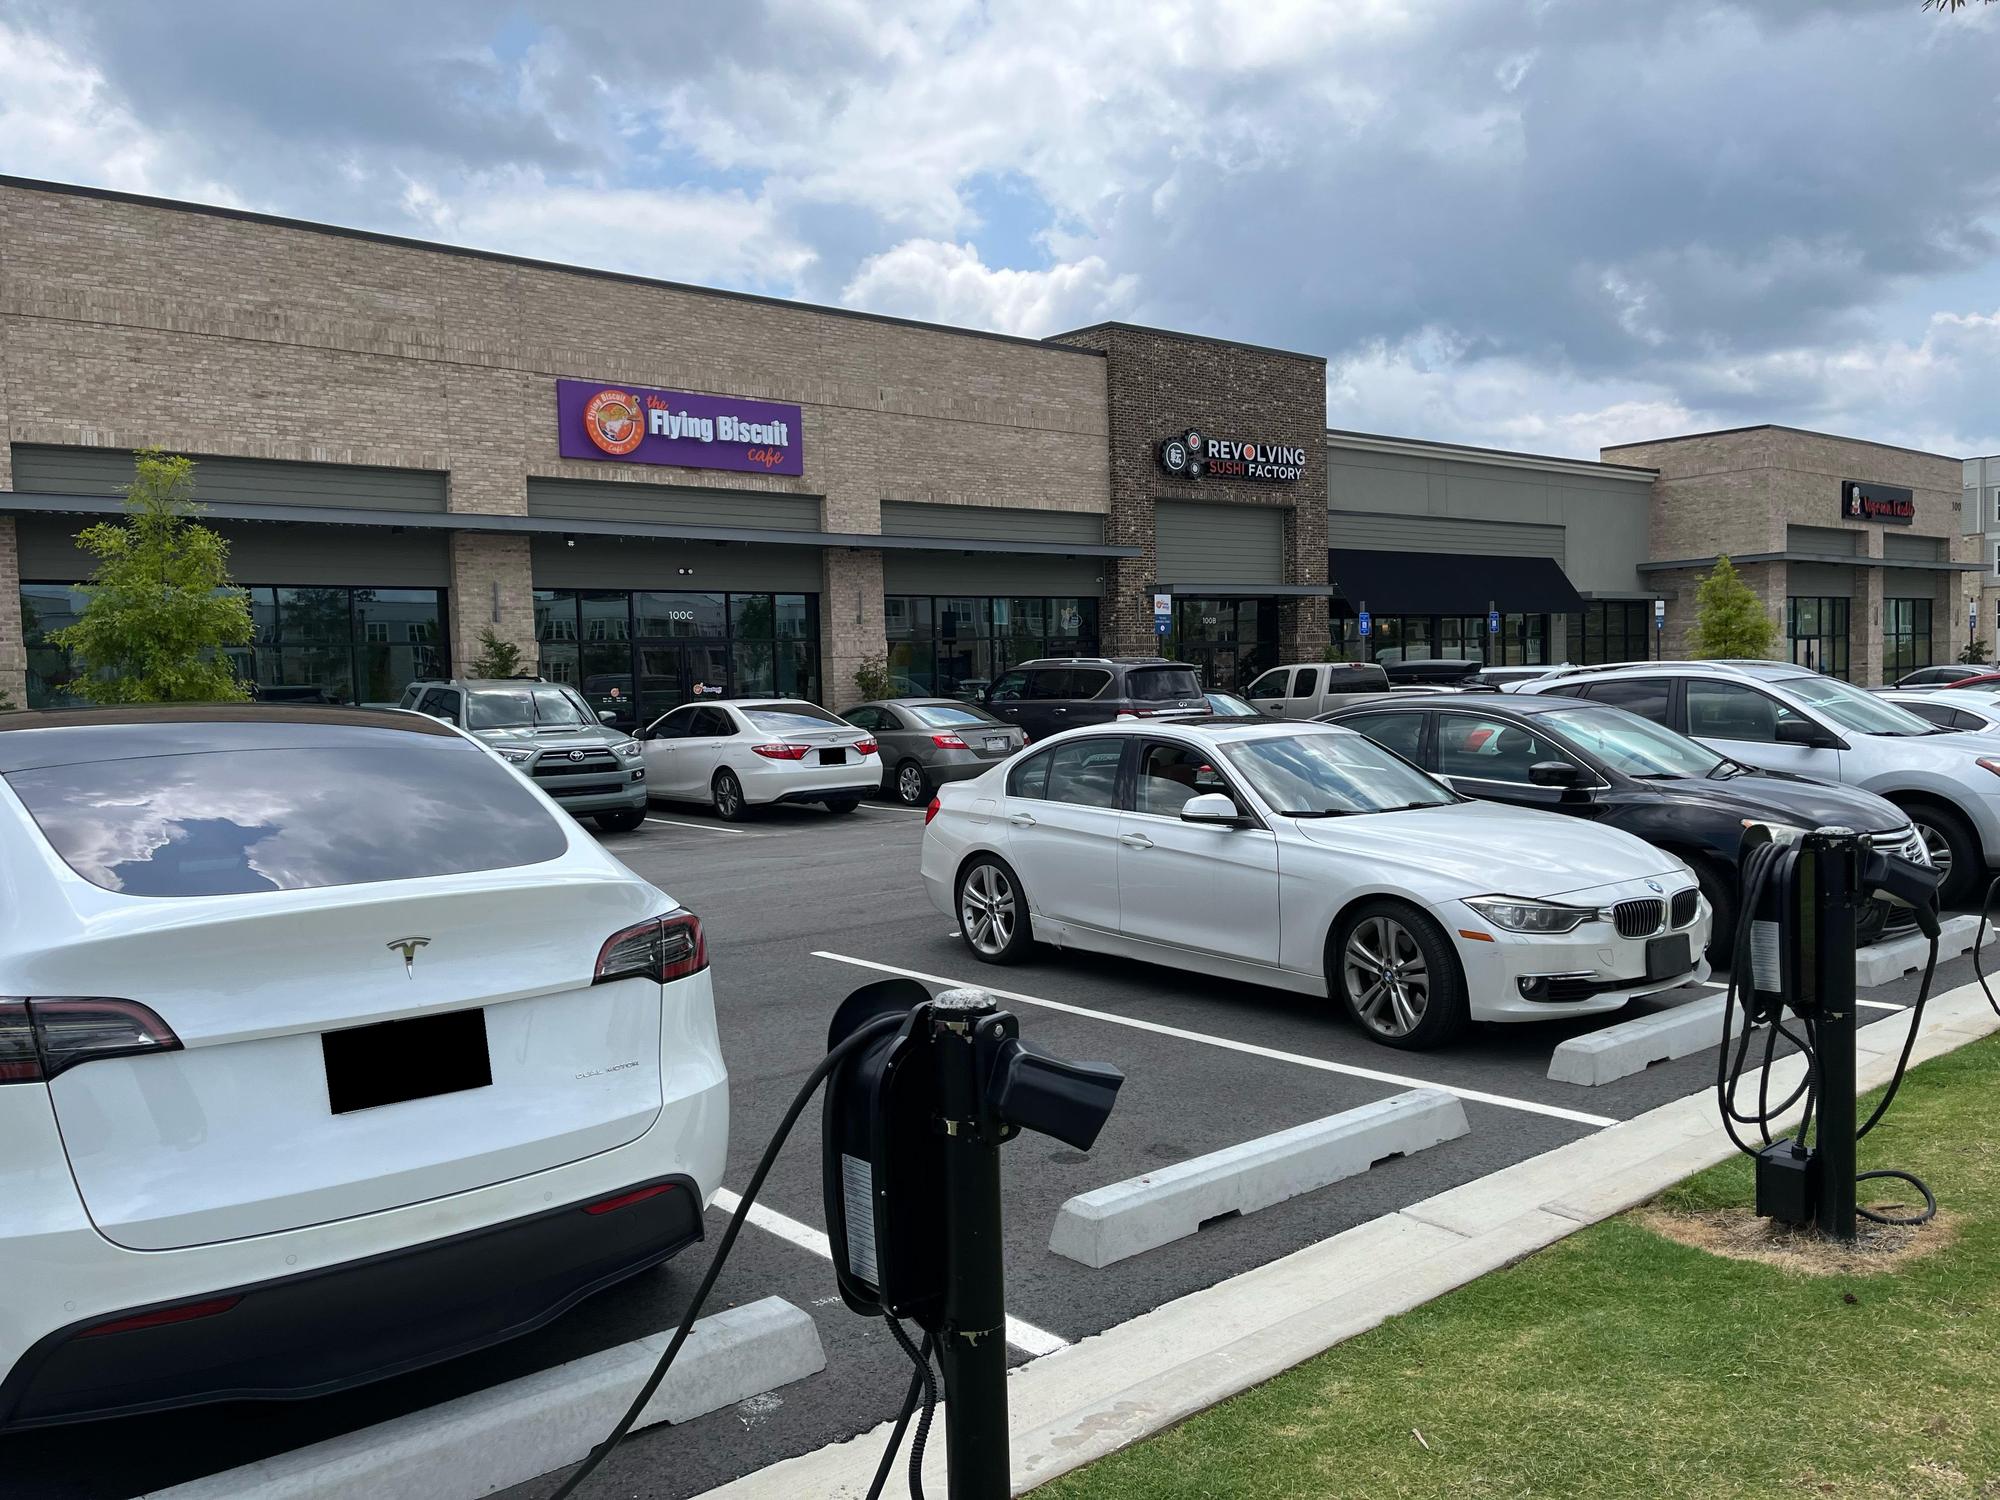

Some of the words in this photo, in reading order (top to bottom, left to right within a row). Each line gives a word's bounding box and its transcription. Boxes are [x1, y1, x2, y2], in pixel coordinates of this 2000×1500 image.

[646, 395, 669, 409] the
[648, 409, 714, 442] Flying
[716, 415, 789, 447] Biscuit
[747, 447, 784, 468] cafe
[1208, 439, 1306, 465] REVOLVING
[1209, 460, 1245, 475] SUSHI
[1248, 464, 1302, 480] FACTORY
[668, 610, 694, 620] 100C
